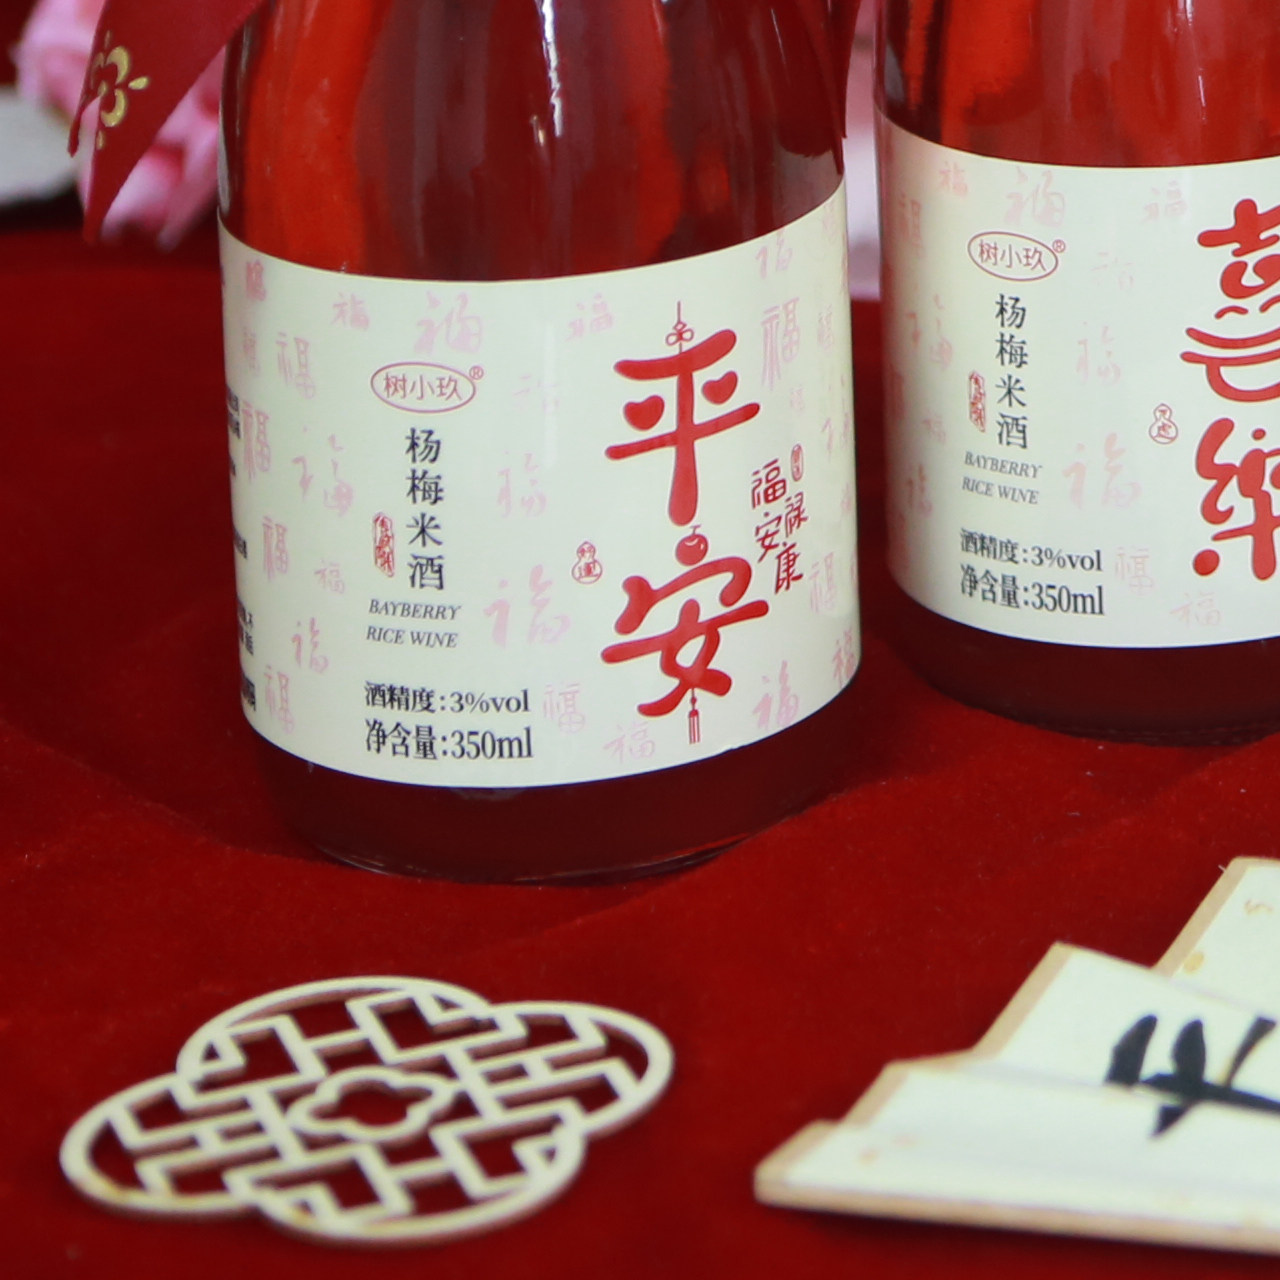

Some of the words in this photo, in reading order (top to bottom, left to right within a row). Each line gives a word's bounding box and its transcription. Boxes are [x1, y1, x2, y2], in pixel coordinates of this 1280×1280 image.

[978, 240, 1047, 272] 树小玖
[995, 294, 1029, 449] 杨梅米酒
[383, 372, 462, 402] 树小玖
[964, 450, 1042, 480] BAYBERRY
[961, 476, 993, 497] RICE
[998, 485, 1040, 506] WINE
[405, 426, 445, 591] 杨梅米酒
[600, 328, 768, 718] 平安
[368, 598, 462, 621] BAYBERRY
[366, 625, 405, 646] RICE
[410, 630, 458, 649] WINE
